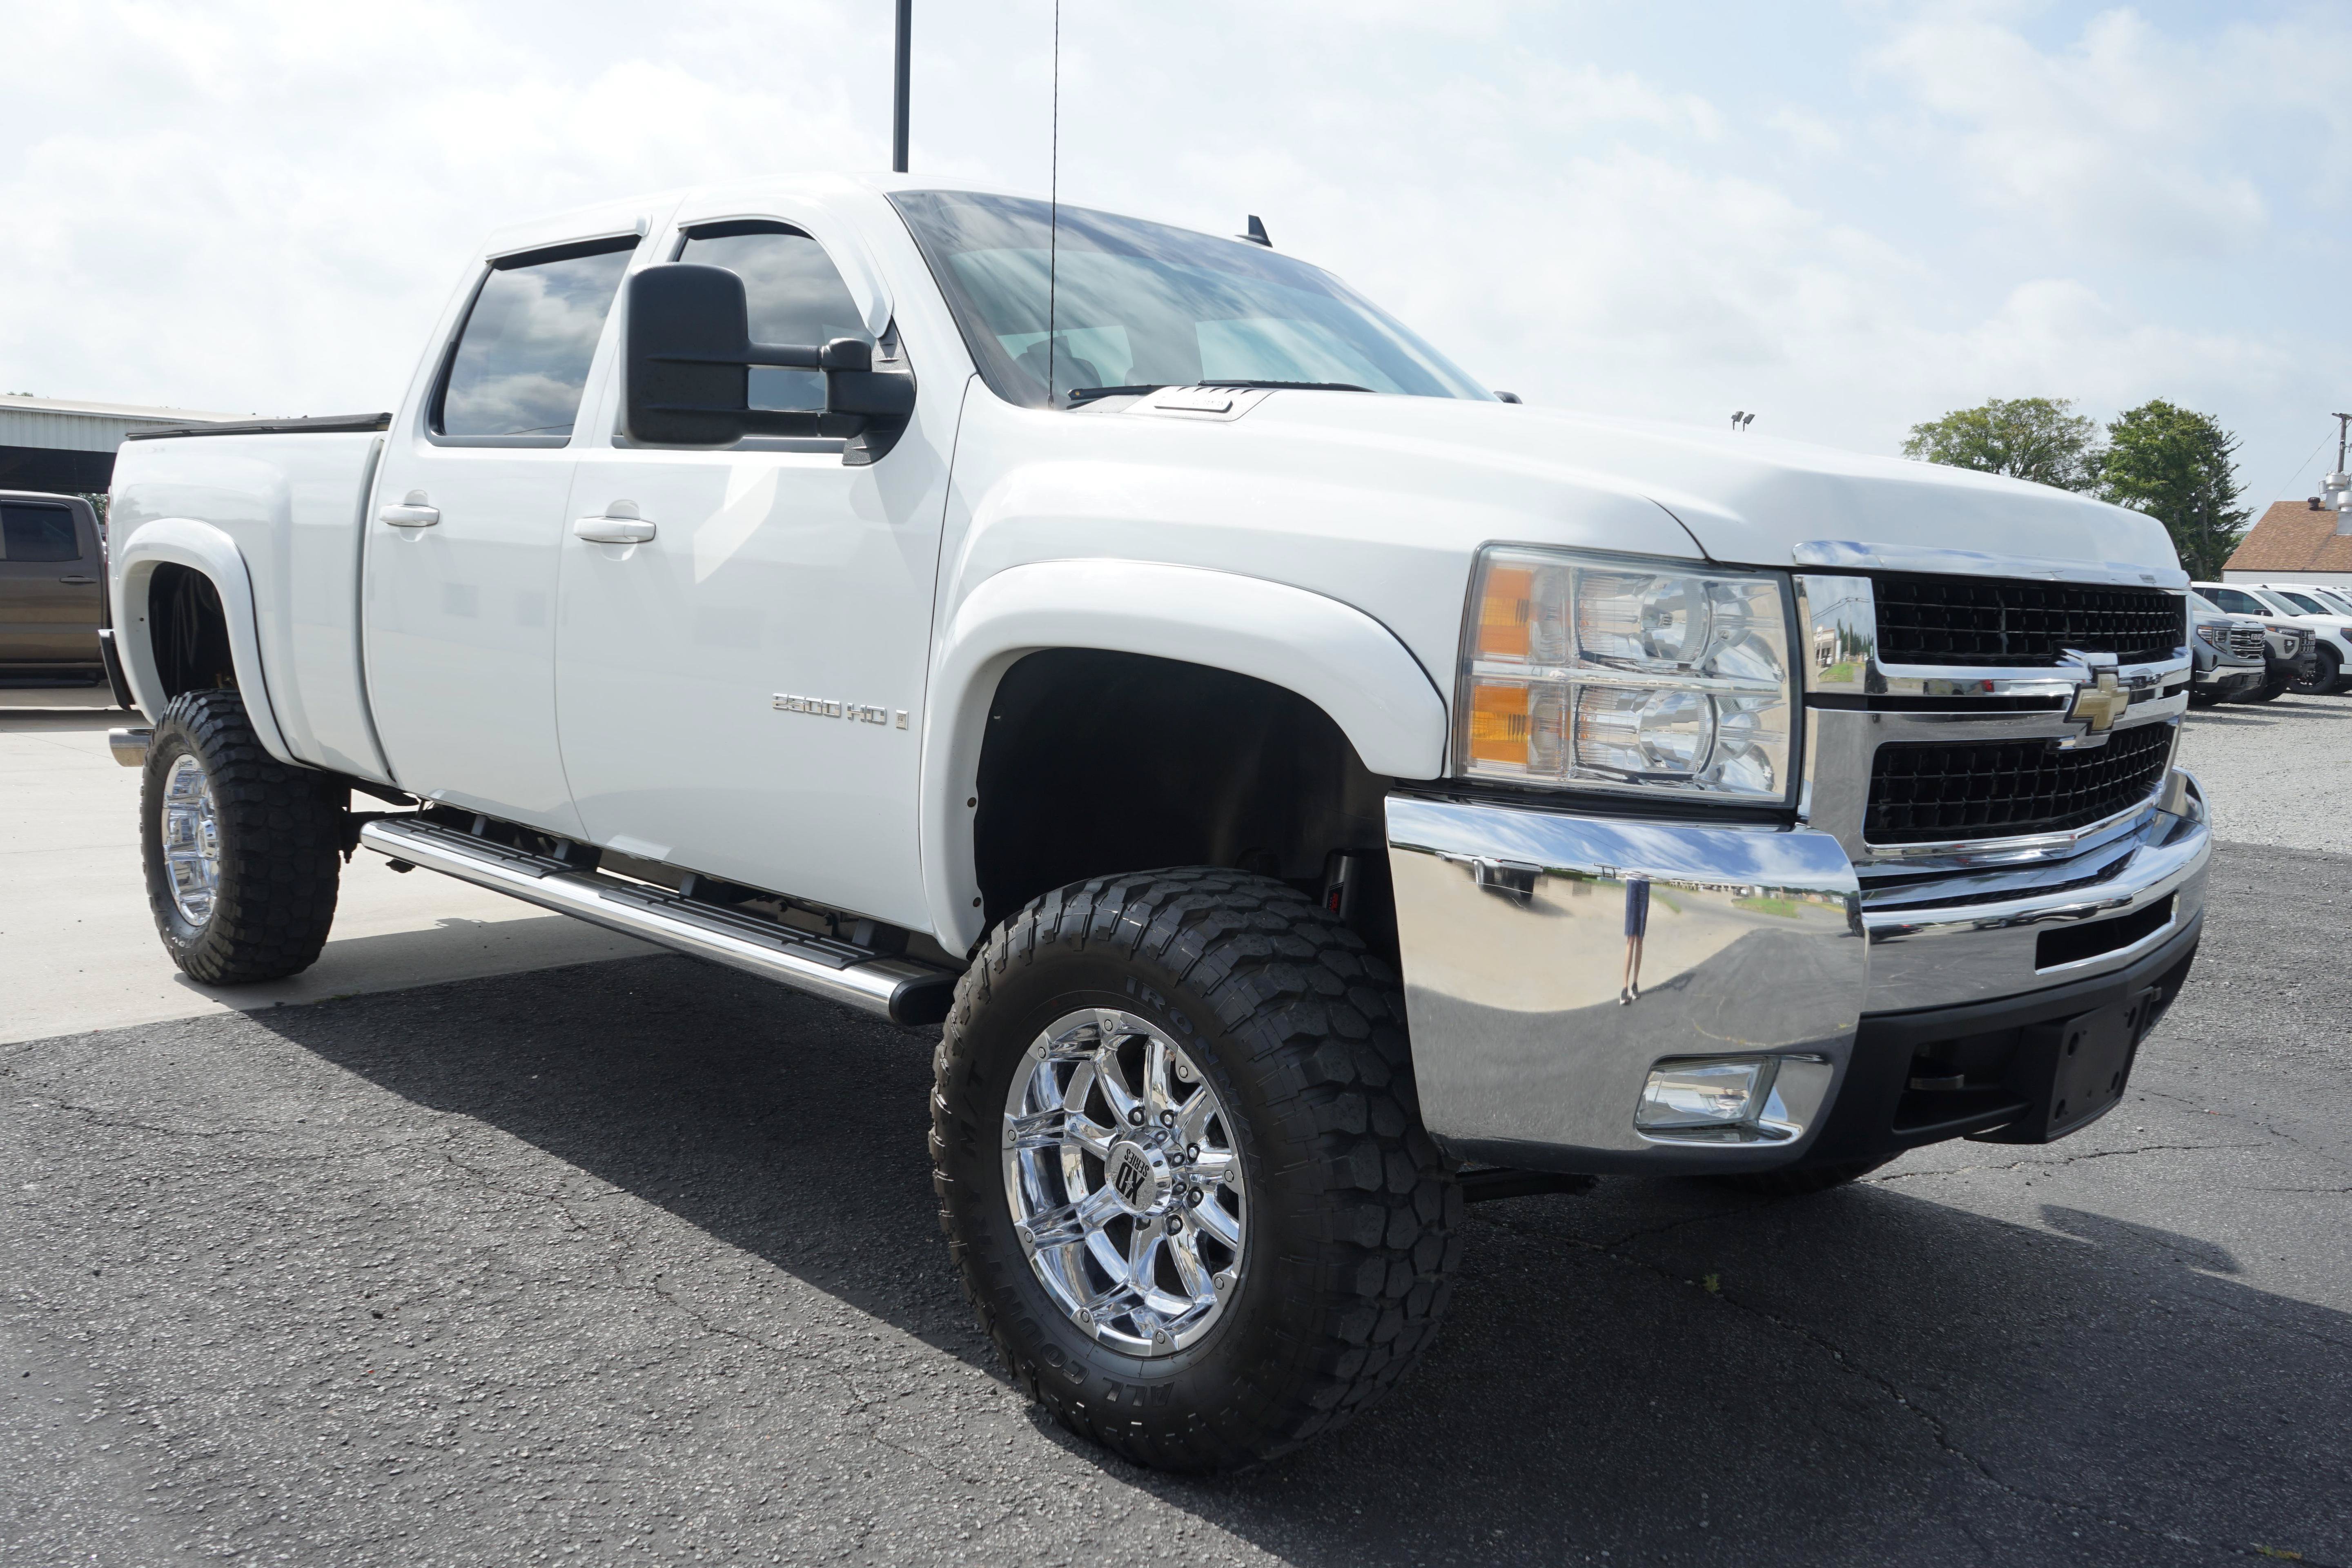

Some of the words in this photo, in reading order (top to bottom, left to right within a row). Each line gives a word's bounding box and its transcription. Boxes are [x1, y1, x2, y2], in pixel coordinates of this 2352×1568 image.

[772, 692, 842, 718] 2500
[846, 702, 887, 725] HD
[1124, 1148, 1149, 1177] SERIES
[1116, 1162, 1145, 1205] XD
[1102, 1376, 1174, 1407] ALL
